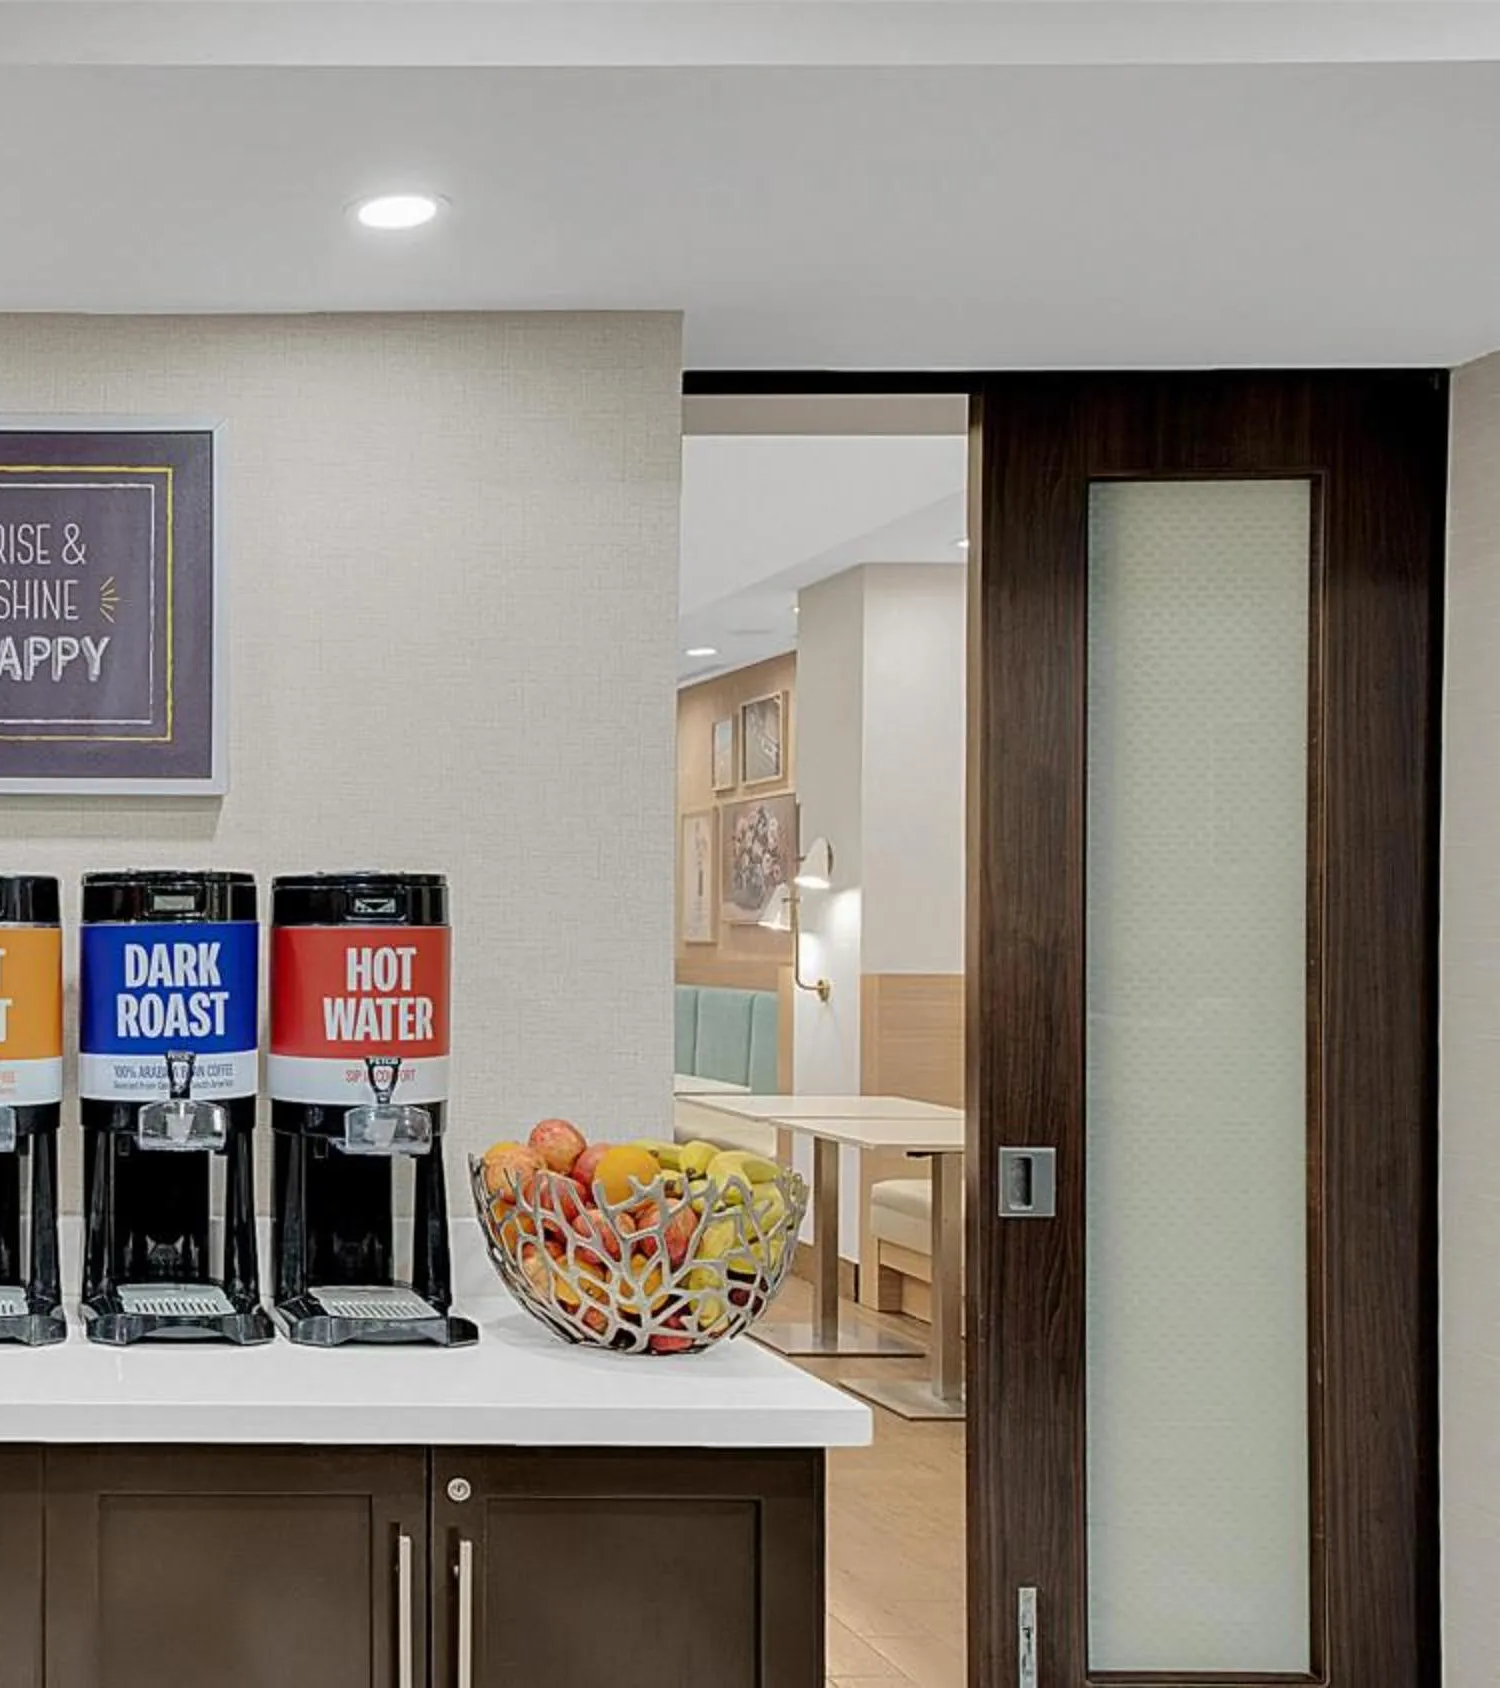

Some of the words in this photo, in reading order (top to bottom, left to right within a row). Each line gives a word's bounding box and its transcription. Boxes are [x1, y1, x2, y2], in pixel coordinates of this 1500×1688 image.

[61, 523, 87, 565] &
[124, 942, 222, 988] DARK
[345, 947, 418, 992] HOT
[116, 992, 230, 1039] ROAST
[323, 997, 435, 1042] WATER
